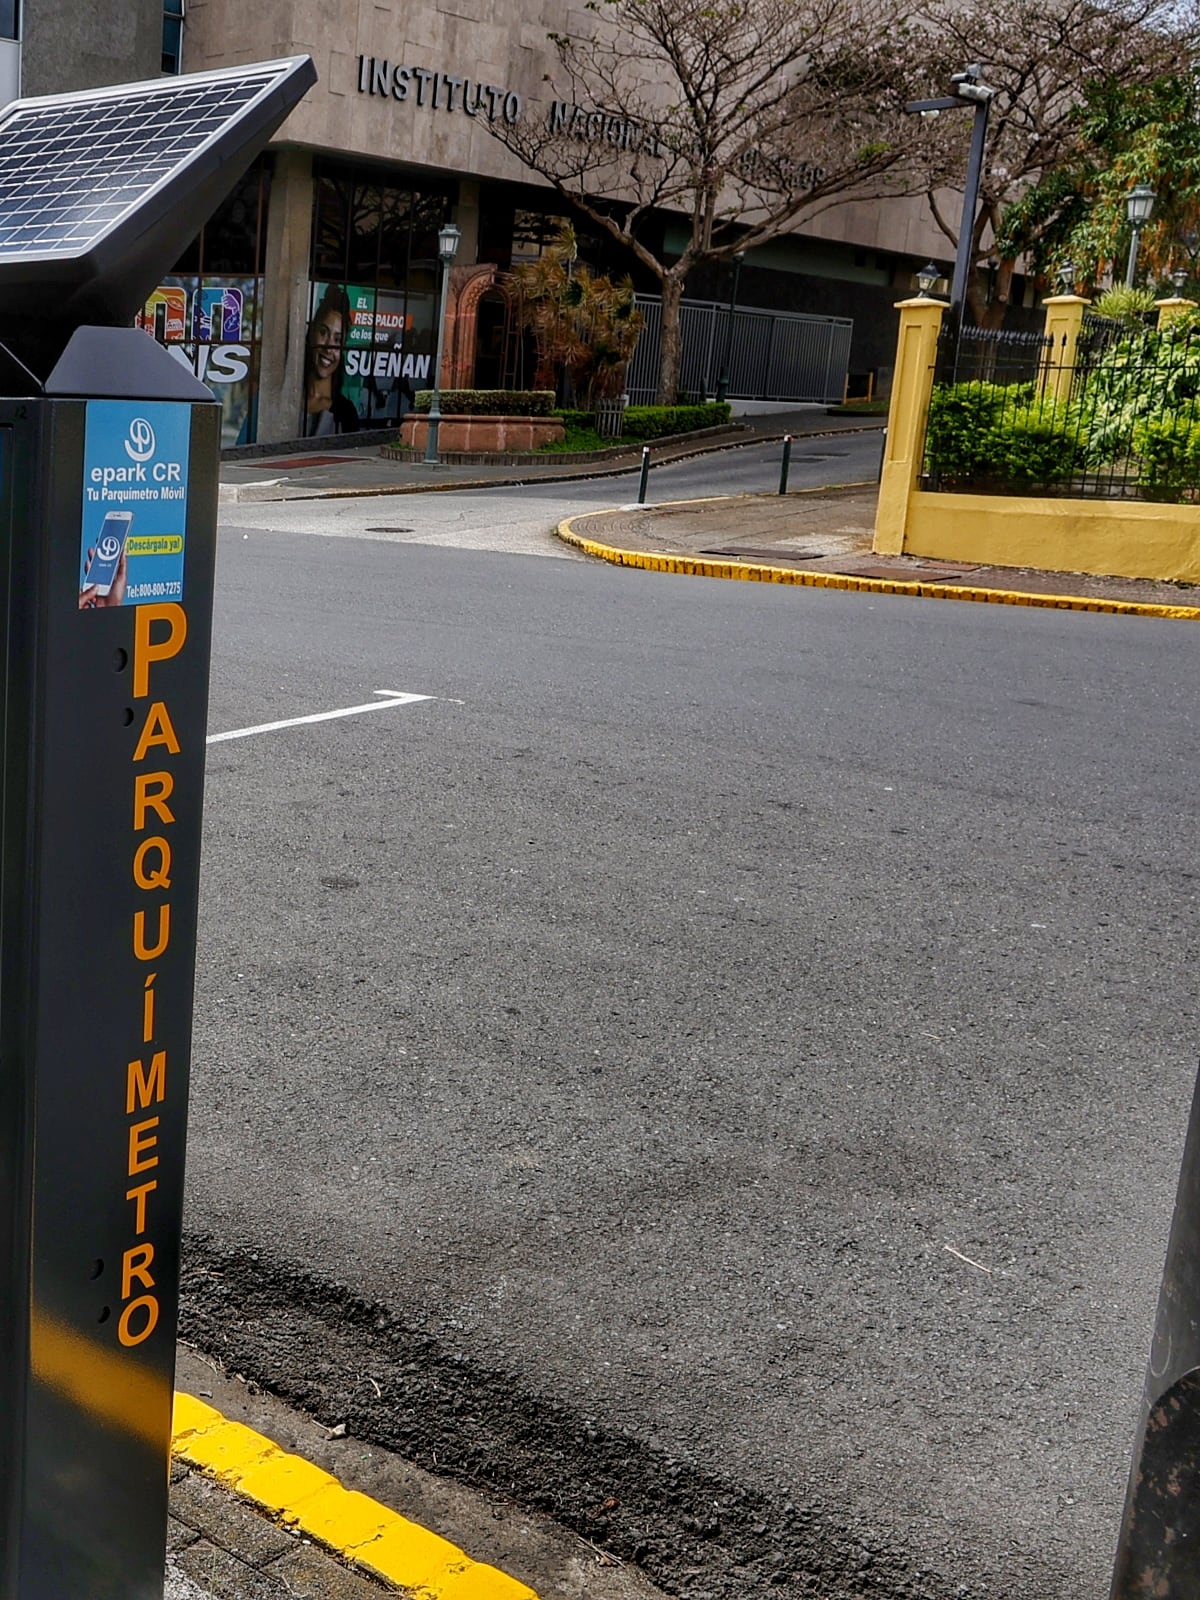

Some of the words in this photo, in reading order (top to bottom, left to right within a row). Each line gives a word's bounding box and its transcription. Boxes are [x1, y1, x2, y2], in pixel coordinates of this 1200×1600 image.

[357, 54, 523, 125] INSTITUTO
[357, 297, 368, 309] EL
[354, 312, 405, 329] RESPALDO
[350, 328, 360, 339] de
[361, 329, 372, 340] los
[374, 332, 389, 343] que
[345, 343, 431, 379] SUEÑAN
[90, 463, 147, 486] epark
[152, 463, 181, 482] CR
[87, 488, 99, 501] Tu
[101, 487, 159, 503] Parquímetro
[161, 486, 185, 500] Móvil
[117, 602, 189, 1347] PARQUÍMETRO
